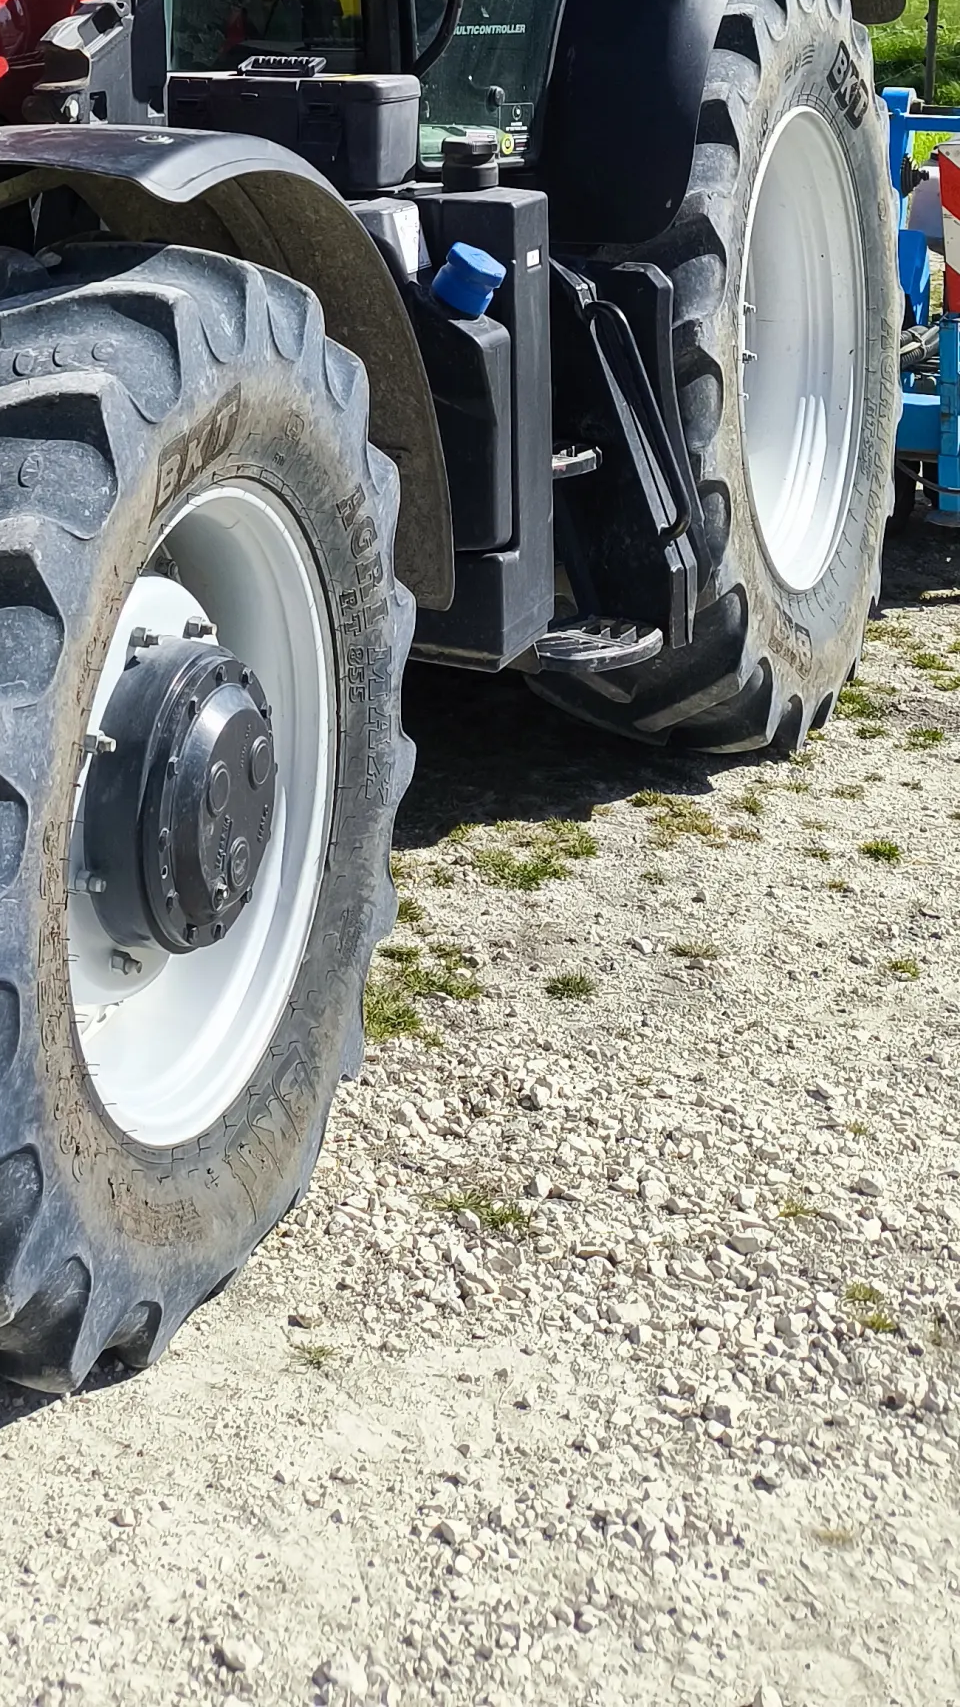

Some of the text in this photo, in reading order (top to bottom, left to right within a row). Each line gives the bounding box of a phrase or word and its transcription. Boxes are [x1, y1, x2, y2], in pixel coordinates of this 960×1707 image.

[454, 24, 526, 35] ULTICONTROLLER
[826, 40, 869, 129] BKT
[153, 389, 241, 516] BKT
[336, 483, 392, 805] AGRI MAX
[339, 588, 366, 703] RT 855
